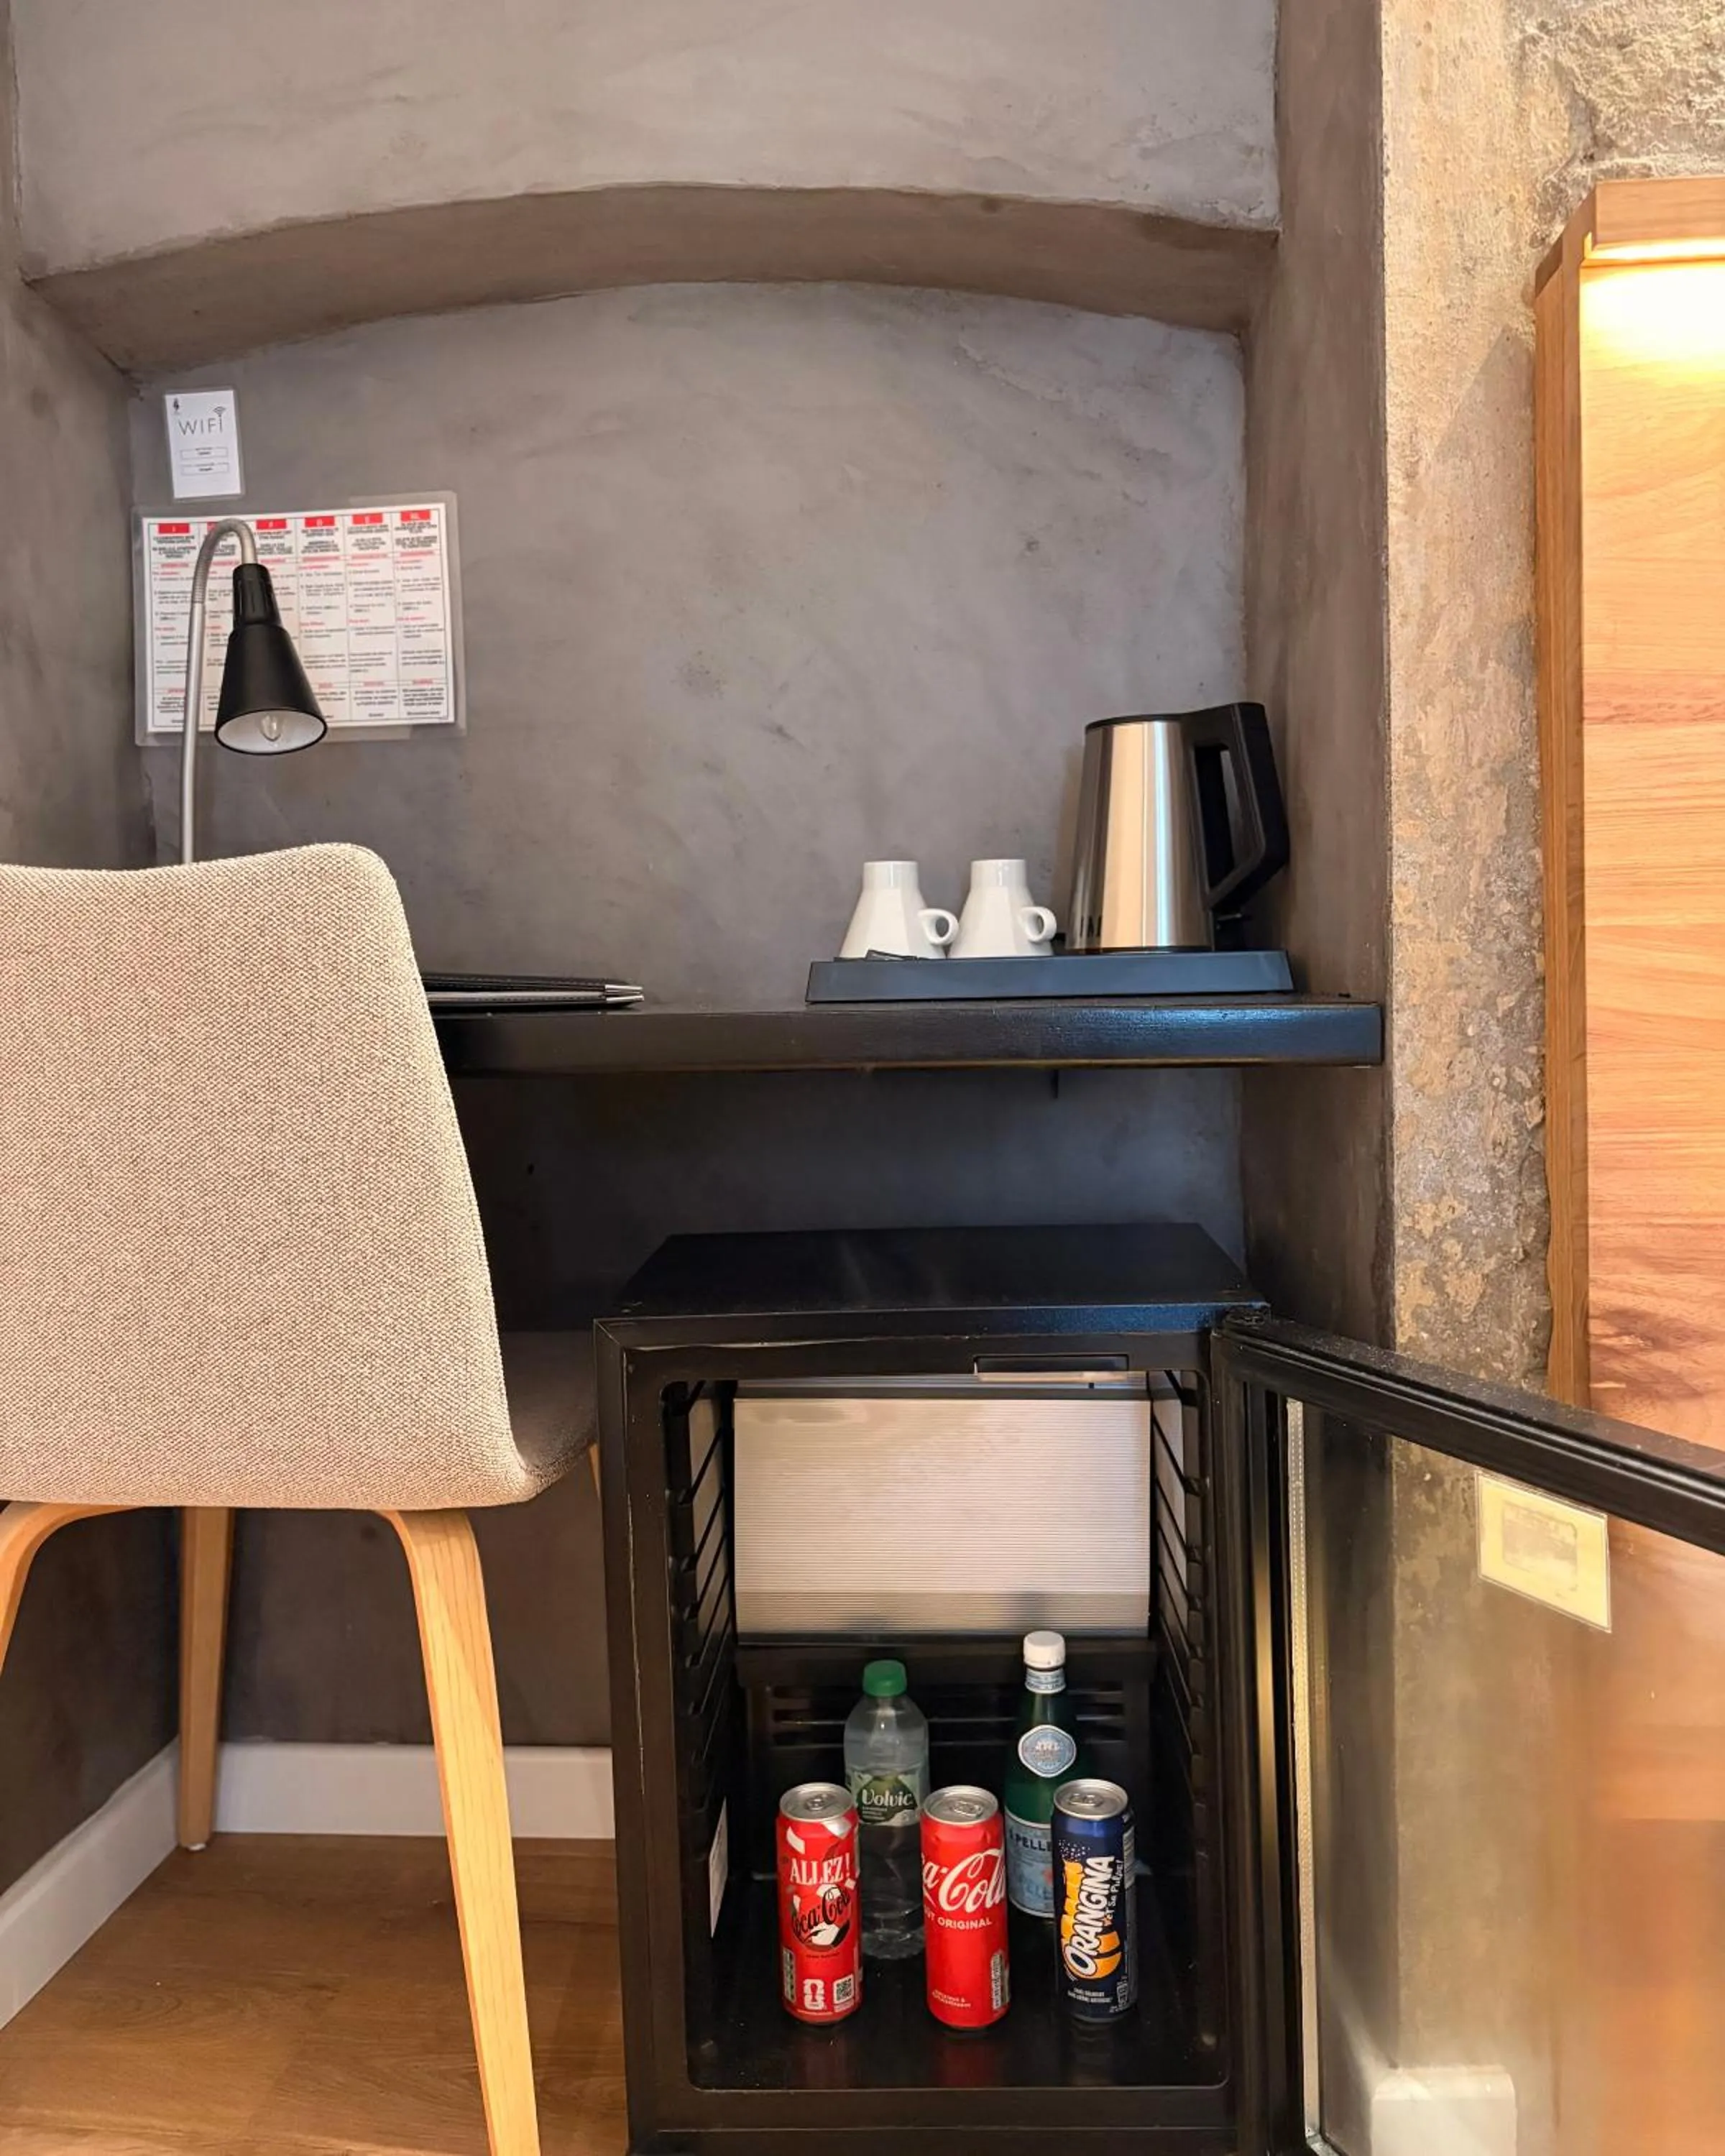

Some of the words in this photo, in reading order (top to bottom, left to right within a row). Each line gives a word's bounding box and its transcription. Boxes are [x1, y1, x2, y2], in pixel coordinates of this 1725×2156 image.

[862, 1789, 913, 1807] Volvic
[789, 1852, 850, 1886] ALLEZ!
[937, 1916, 993, 1930] ORIGINAL
[1064, 1855, 1115, 1976] ORANGINA
